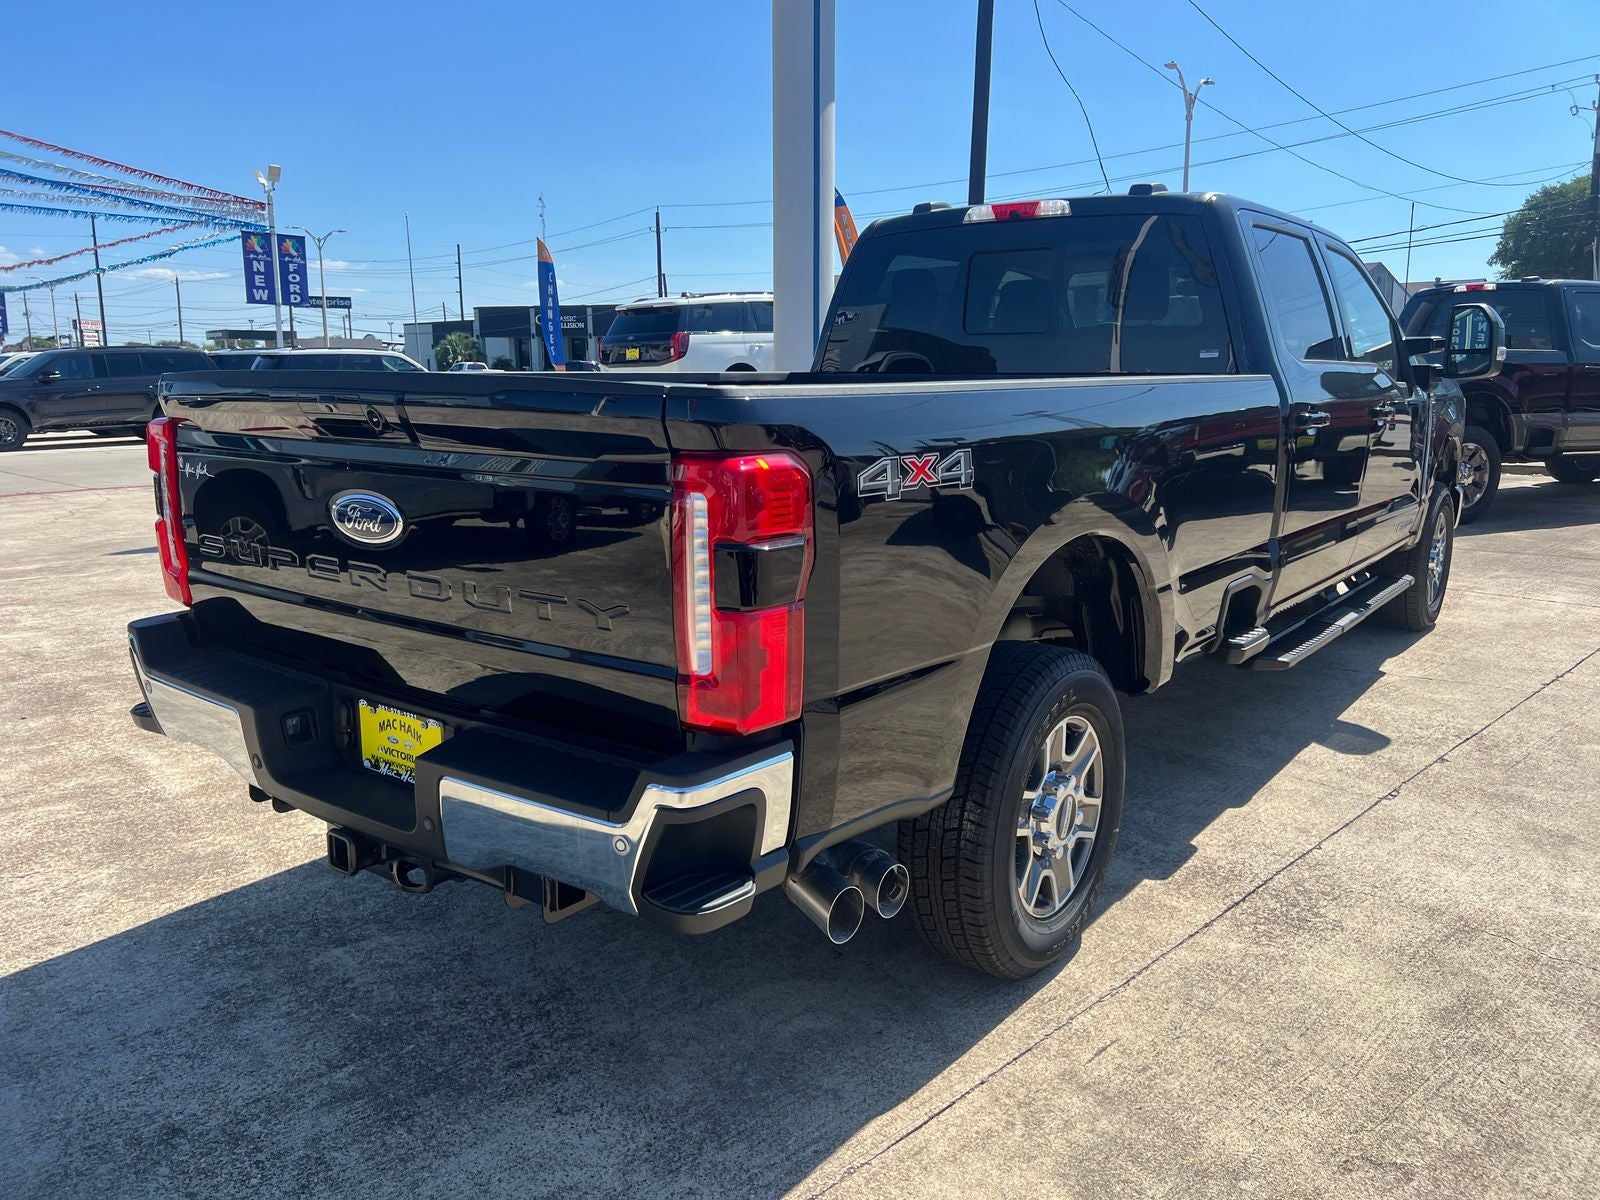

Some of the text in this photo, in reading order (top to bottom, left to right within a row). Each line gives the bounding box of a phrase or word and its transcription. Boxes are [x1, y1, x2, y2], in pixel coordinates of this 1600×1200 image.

[252, 261, 269, 301] NEW
[288, 263, 301, 303] FORD
[308, 298, 351, 307] nteprise
[547, 272, 555, 356] CHANGES
[344, 504, 382, 533] Ford
[198, 533, 630, 632] SUPER DUTY
[379, 719, 398, 733] MAC
[399, 721, 422, 746] HAIK
[379, 762, 400, 779] Mac
